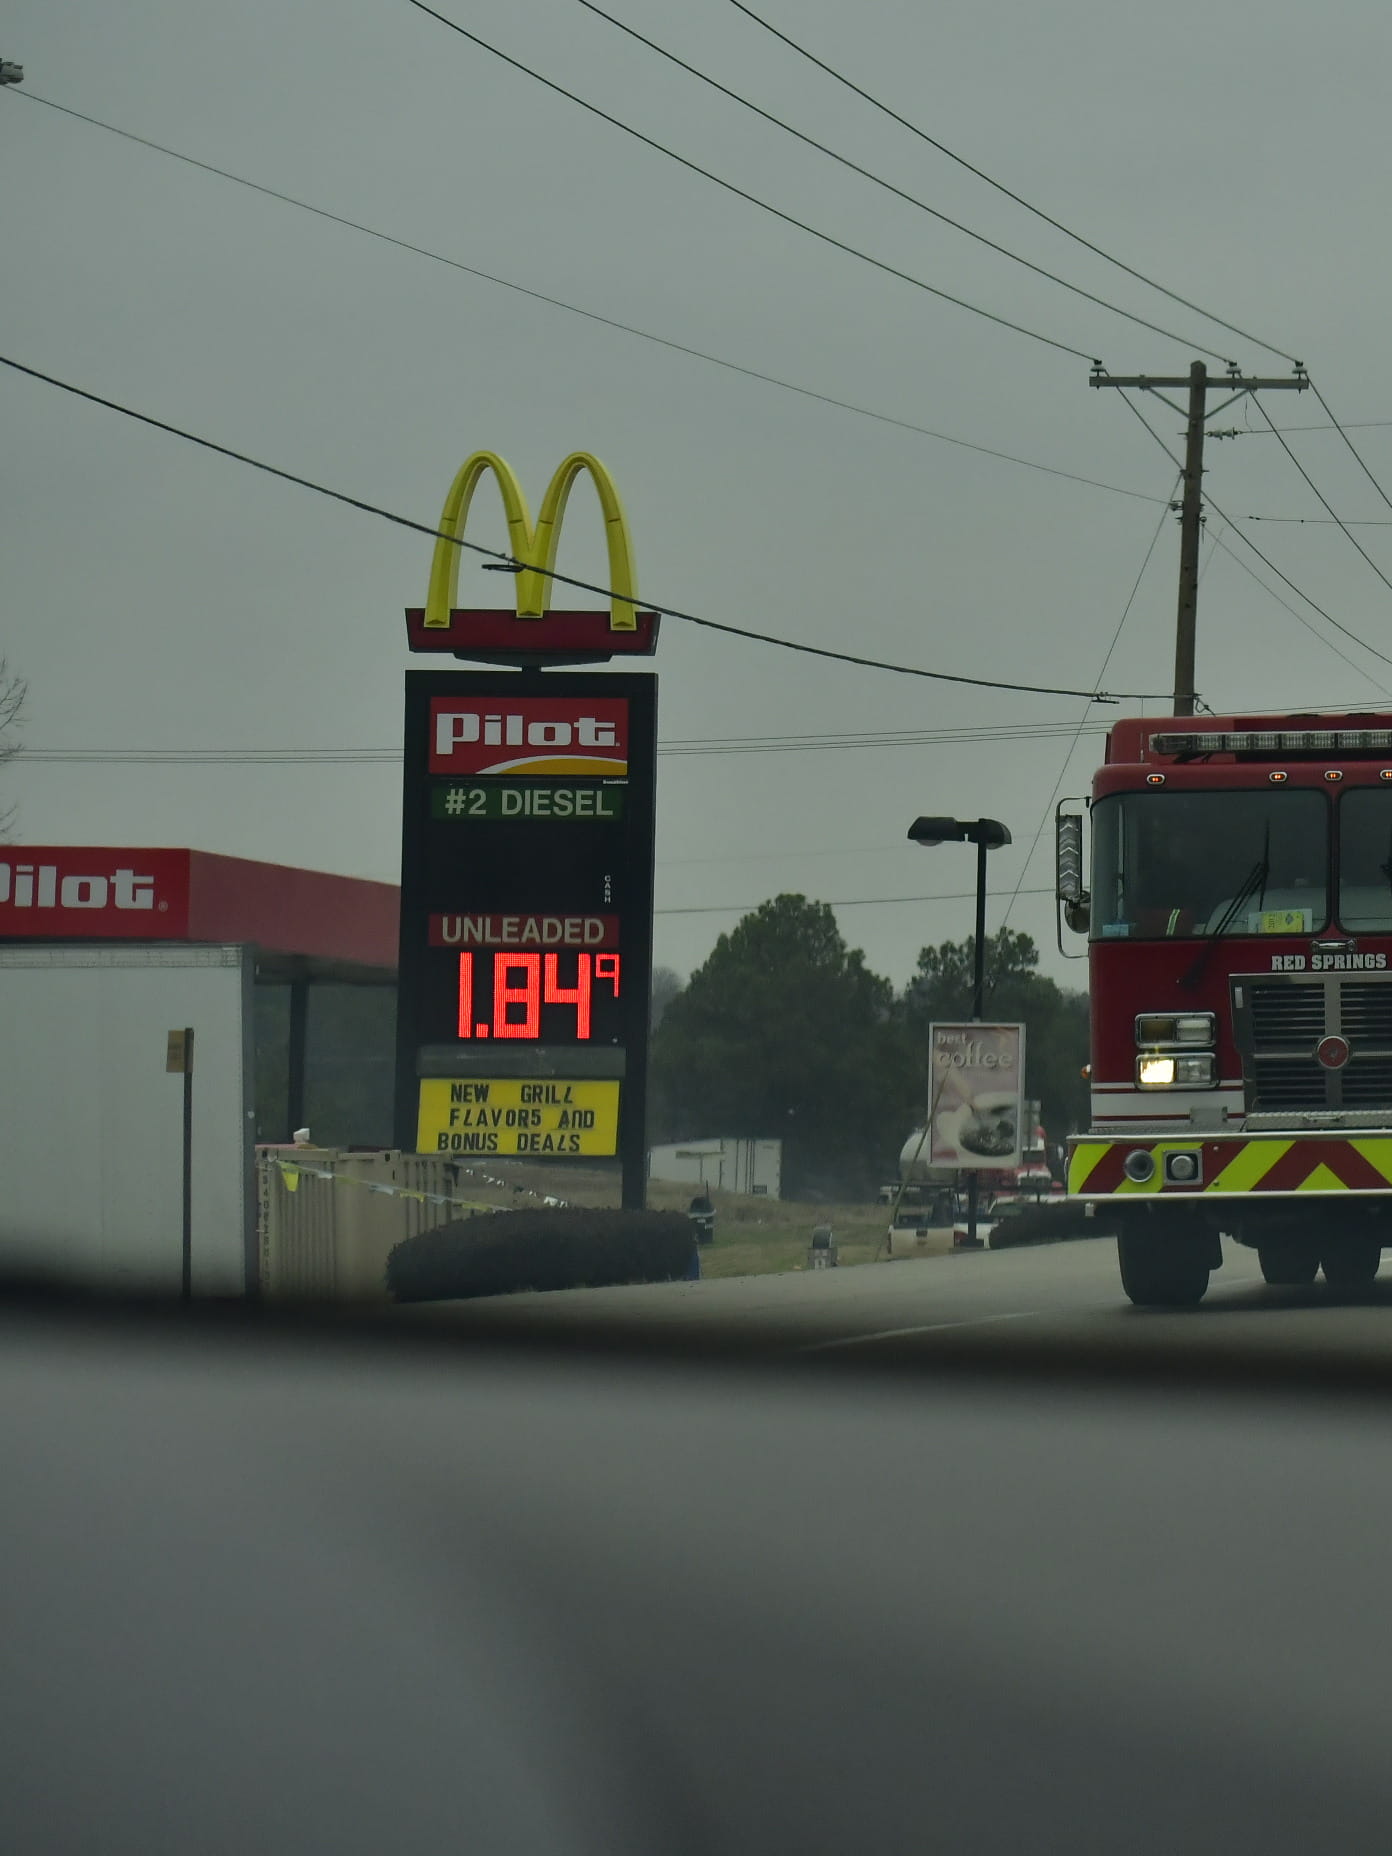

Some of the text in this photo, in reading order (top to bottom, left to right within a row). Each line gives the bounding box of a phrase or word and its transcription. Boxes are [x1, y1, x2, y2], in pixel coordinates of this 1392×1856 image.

[436, 713, 616, 754] Pilot
[445, 788, 614, 816] #2 DIESEL
[0, 862, 154, 909] ilot
[442, 916, 605, 944] UNLEADED
[1271, 953, 1387, 971] RED SPRINGS
[937, 1040, 1013, 1069] coffee
[450, 1083, 573, 1104] NEW GRILL
[450, 1108, 595, 1129] FLAVORS AND
[438, 1132, 580, 1152] BONUS DEALS
